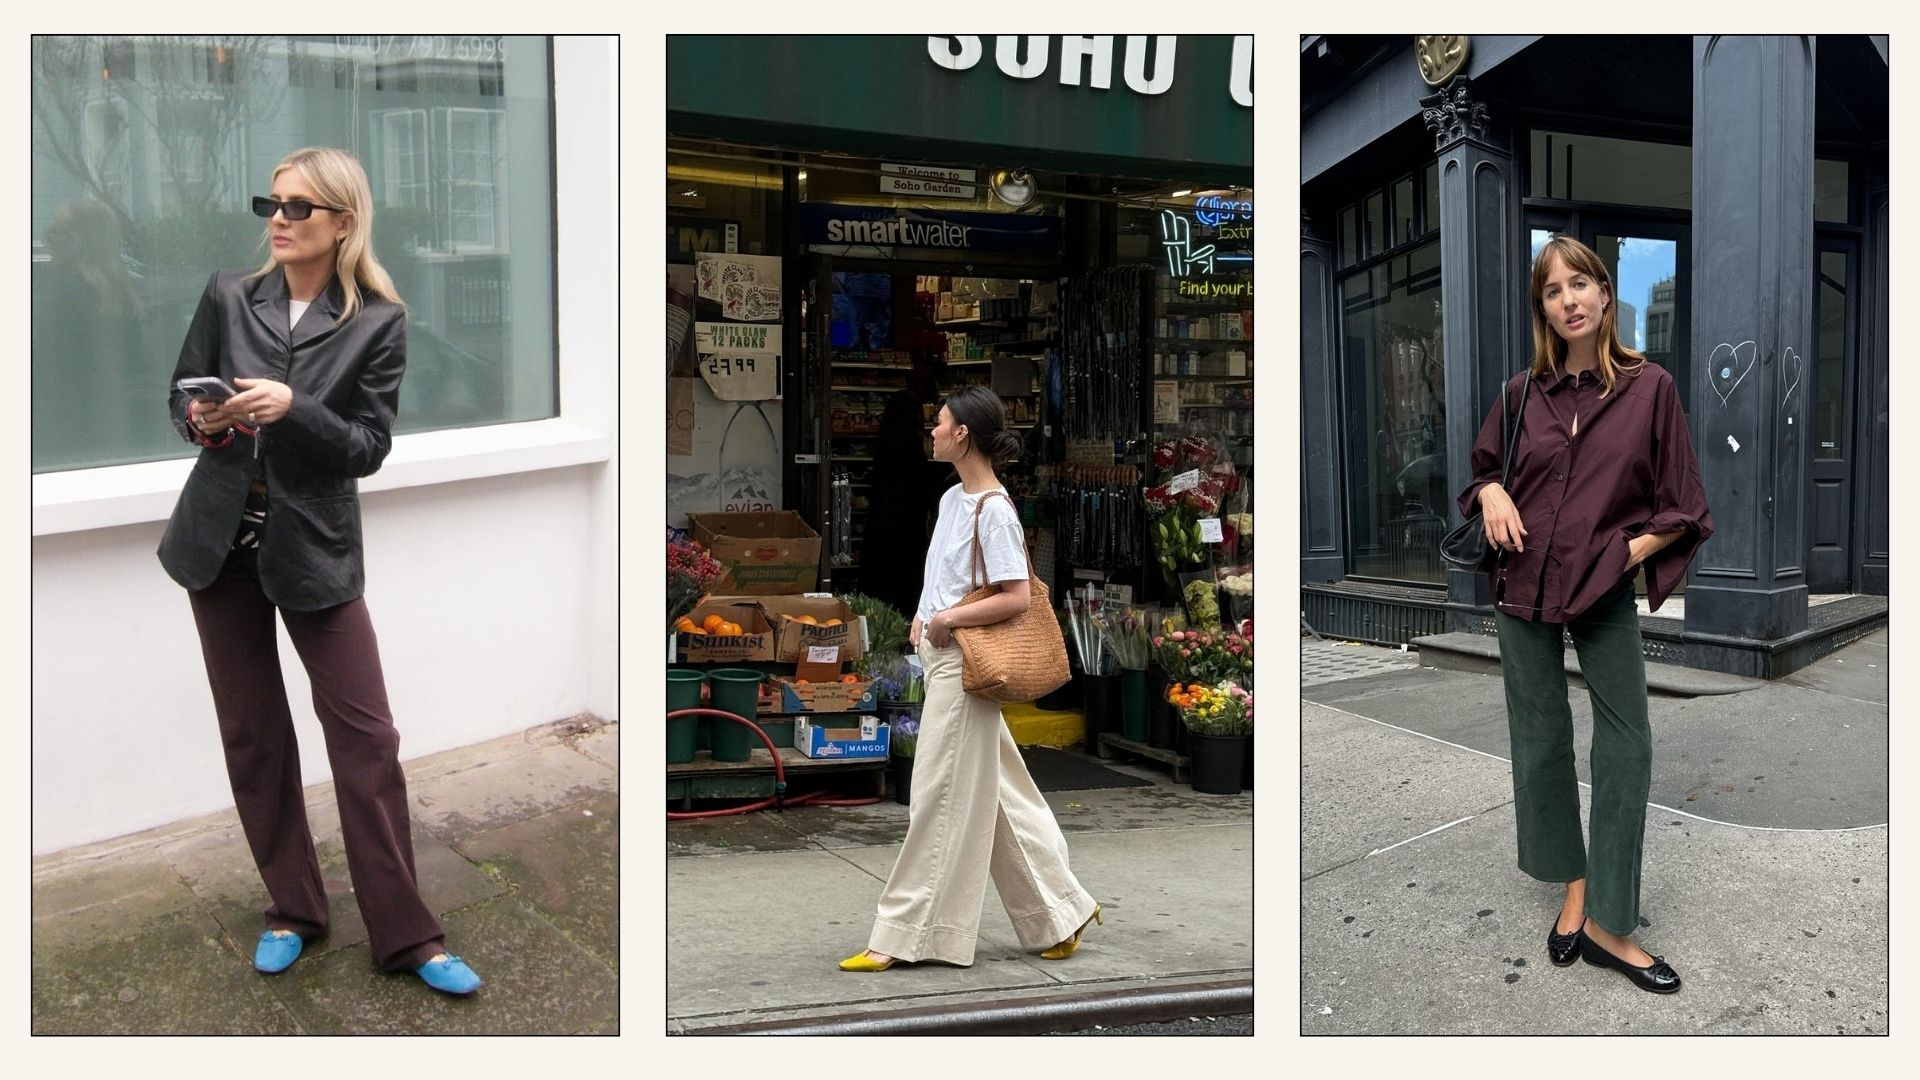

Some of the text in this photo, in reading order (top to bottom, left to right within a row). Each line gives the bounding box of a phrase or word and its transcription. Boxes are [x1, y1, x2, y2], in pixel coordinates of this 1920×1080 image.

[897, 166, 960, 180] Welcome to
[893, 180, 962, 194] Soho Garden
[827, 217, 972, 248] smartwater
[1179, 280, 1209, 295] Find
[1212, 283, 1244, 297] your
[710, 325, 767, 337] WHITE CLAW
[712, 336, 724, 347] 12
[729, 336, 766, 348] PACKS
[725, 500, 774, 512] evian
[849, 744, 885, 752] MANGOS
